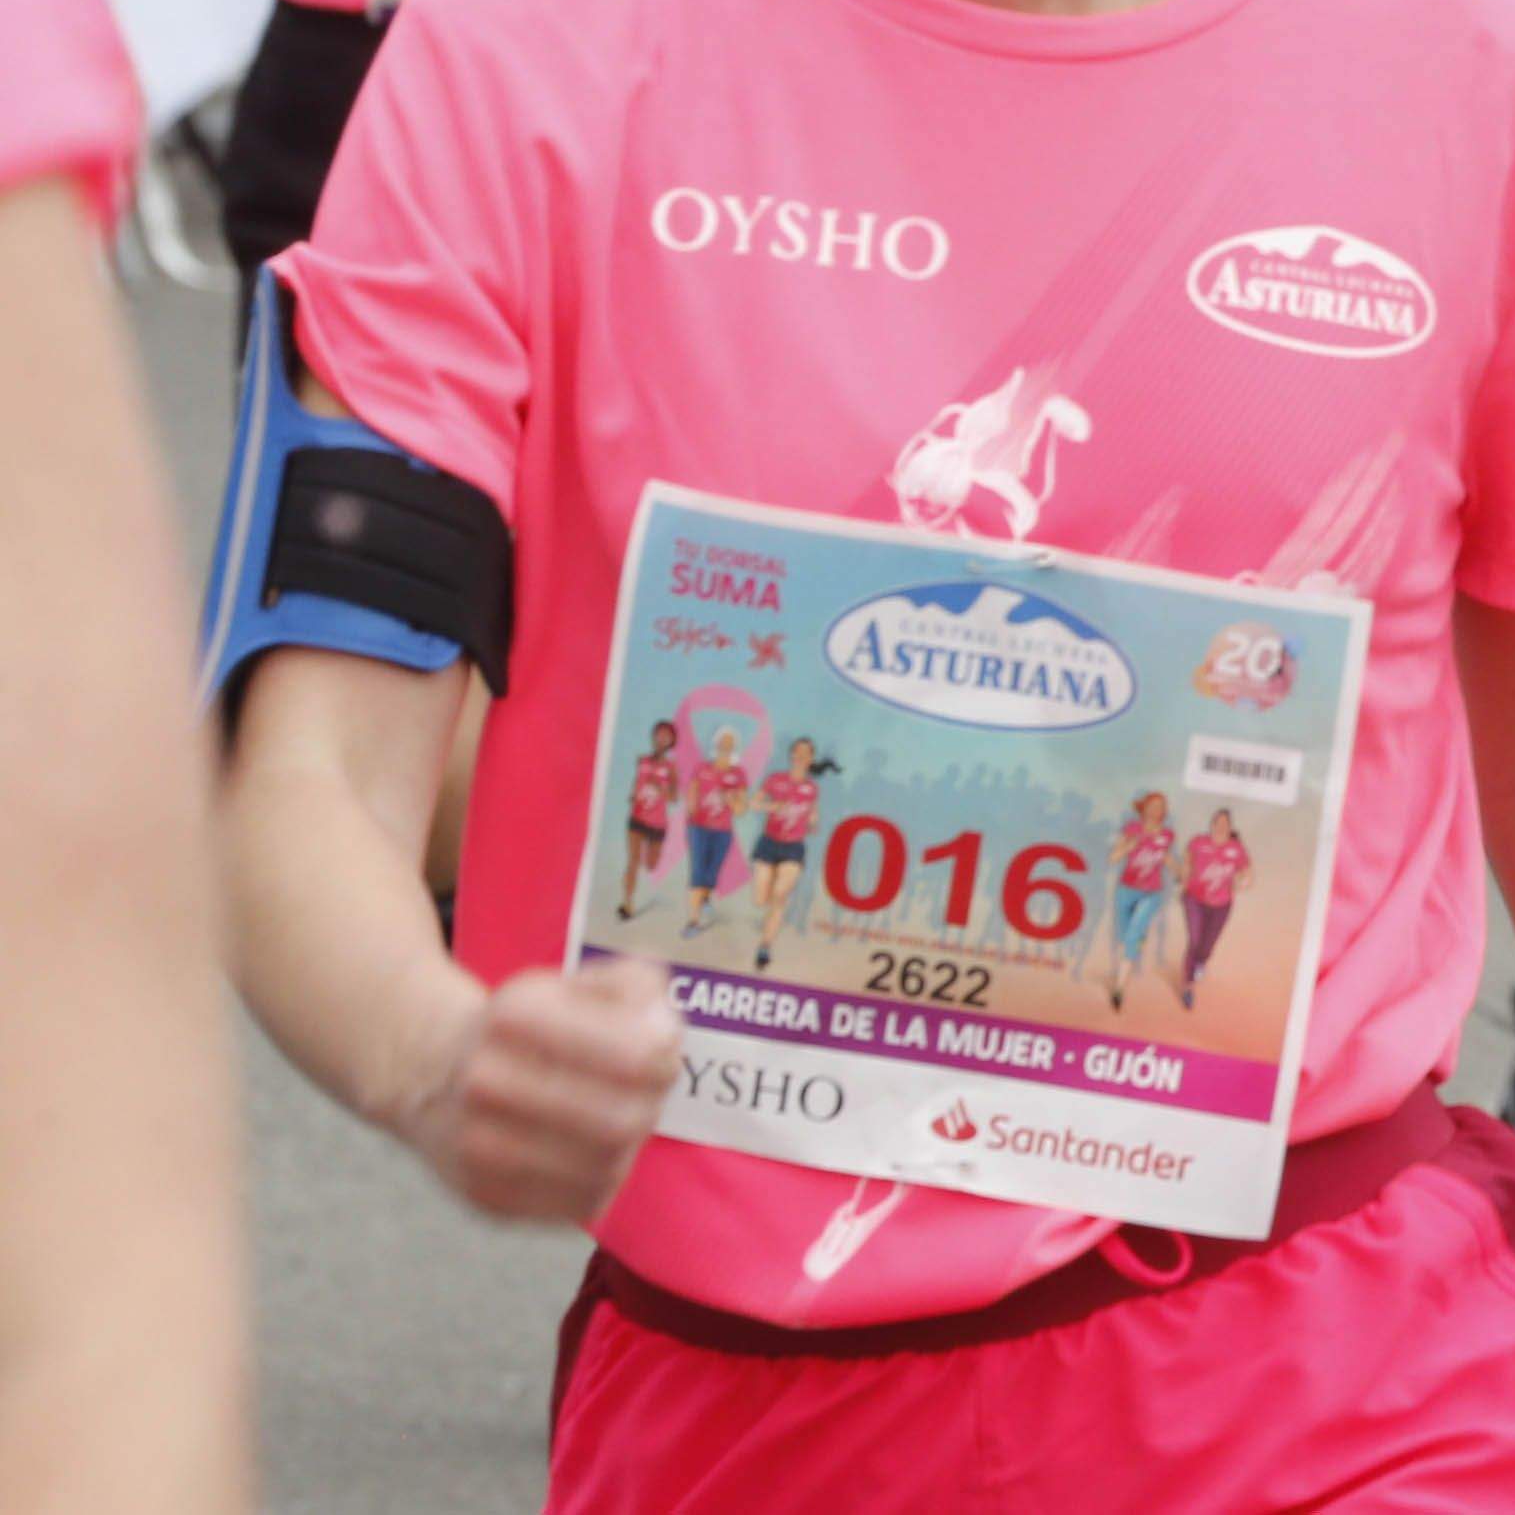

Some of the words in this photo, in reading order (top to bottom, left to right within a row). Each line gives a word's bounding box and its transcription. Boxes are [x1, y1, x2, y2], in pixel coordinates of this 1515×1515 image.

[650, 186, 950, 282] OYSHO
[1206, 257, 1418, 337] ASTURIANA
[670, 562, 782, 614] SUMA
[846, 617, 1111, 710] ASTURIANA
[1214, 630, 1282, 679] 20
[824, 814, 1088, 941] 016
[866, 950, 992, 1008] 2622
[670, 974, 820, 1034] CARRERA
[830, 1003, 877, 1041] DE
[882, 1011, 929, 1049] LA
[936, 1019, 1056, 1071] MUJER
[1083, 1045, 1185, 1094] GIJÓN
[681, 1054, 845, 1124] YSHO
[985, 1115, 1196, 1182] Santander
